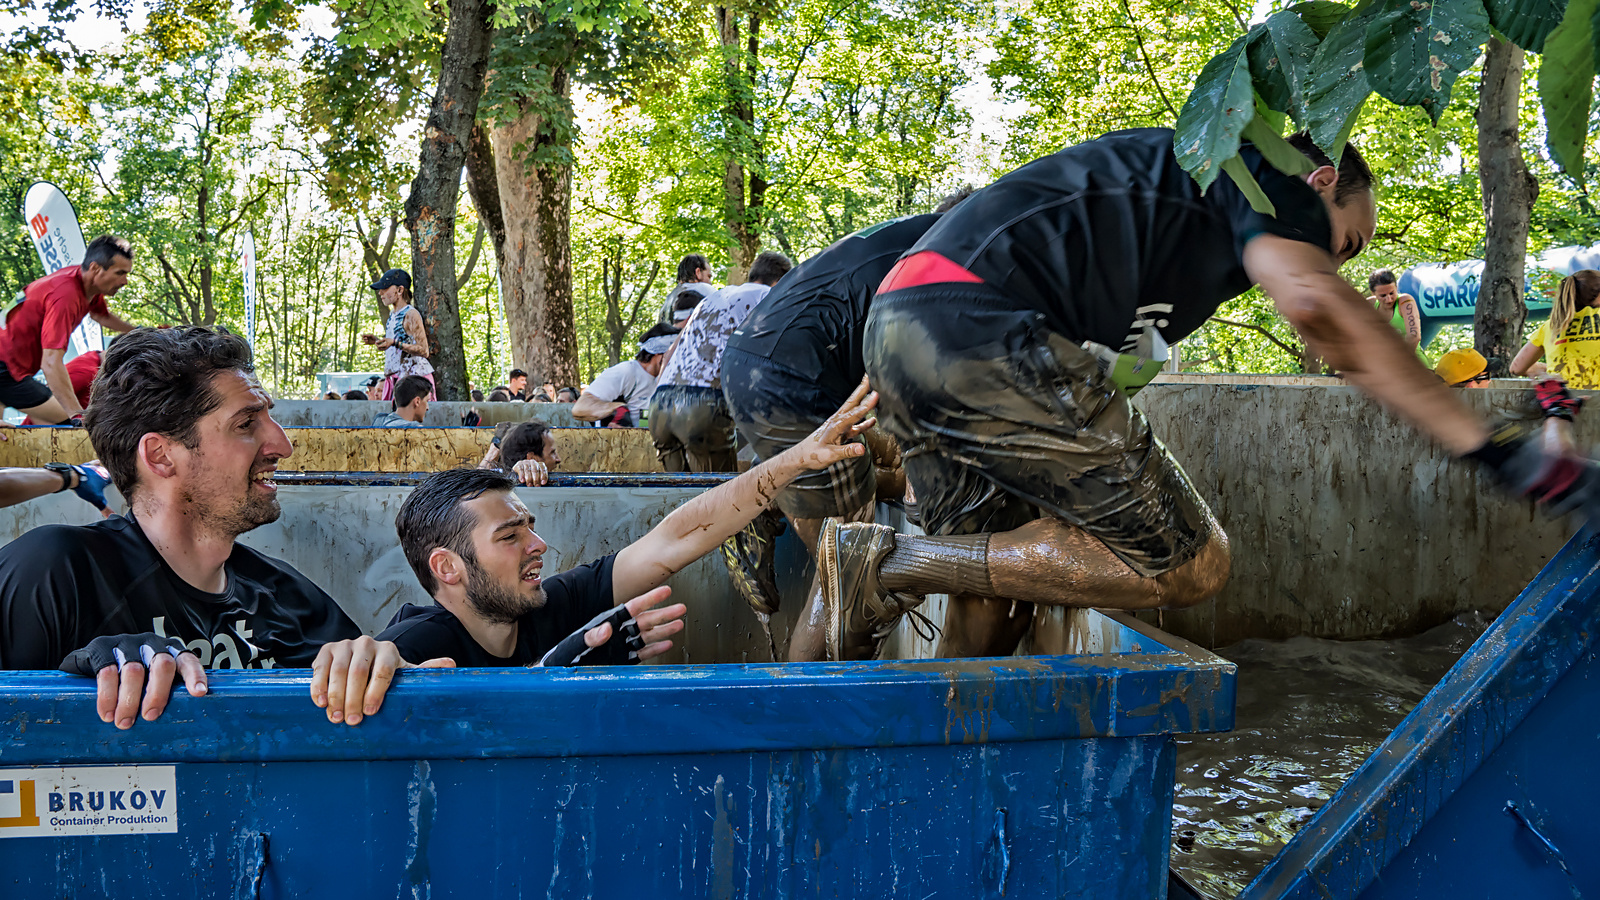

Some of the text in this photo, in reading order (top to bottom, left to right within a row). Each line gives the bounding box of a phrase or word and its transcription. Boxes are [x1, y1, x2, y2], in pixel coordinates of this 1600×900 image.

[1423, 283, 1480, 309] SPARK
[1557, 314, 1600, 338] EA
[48, 789, 167, 812] BRUKOV
[50, 814, 168, 826] Container Produktion
